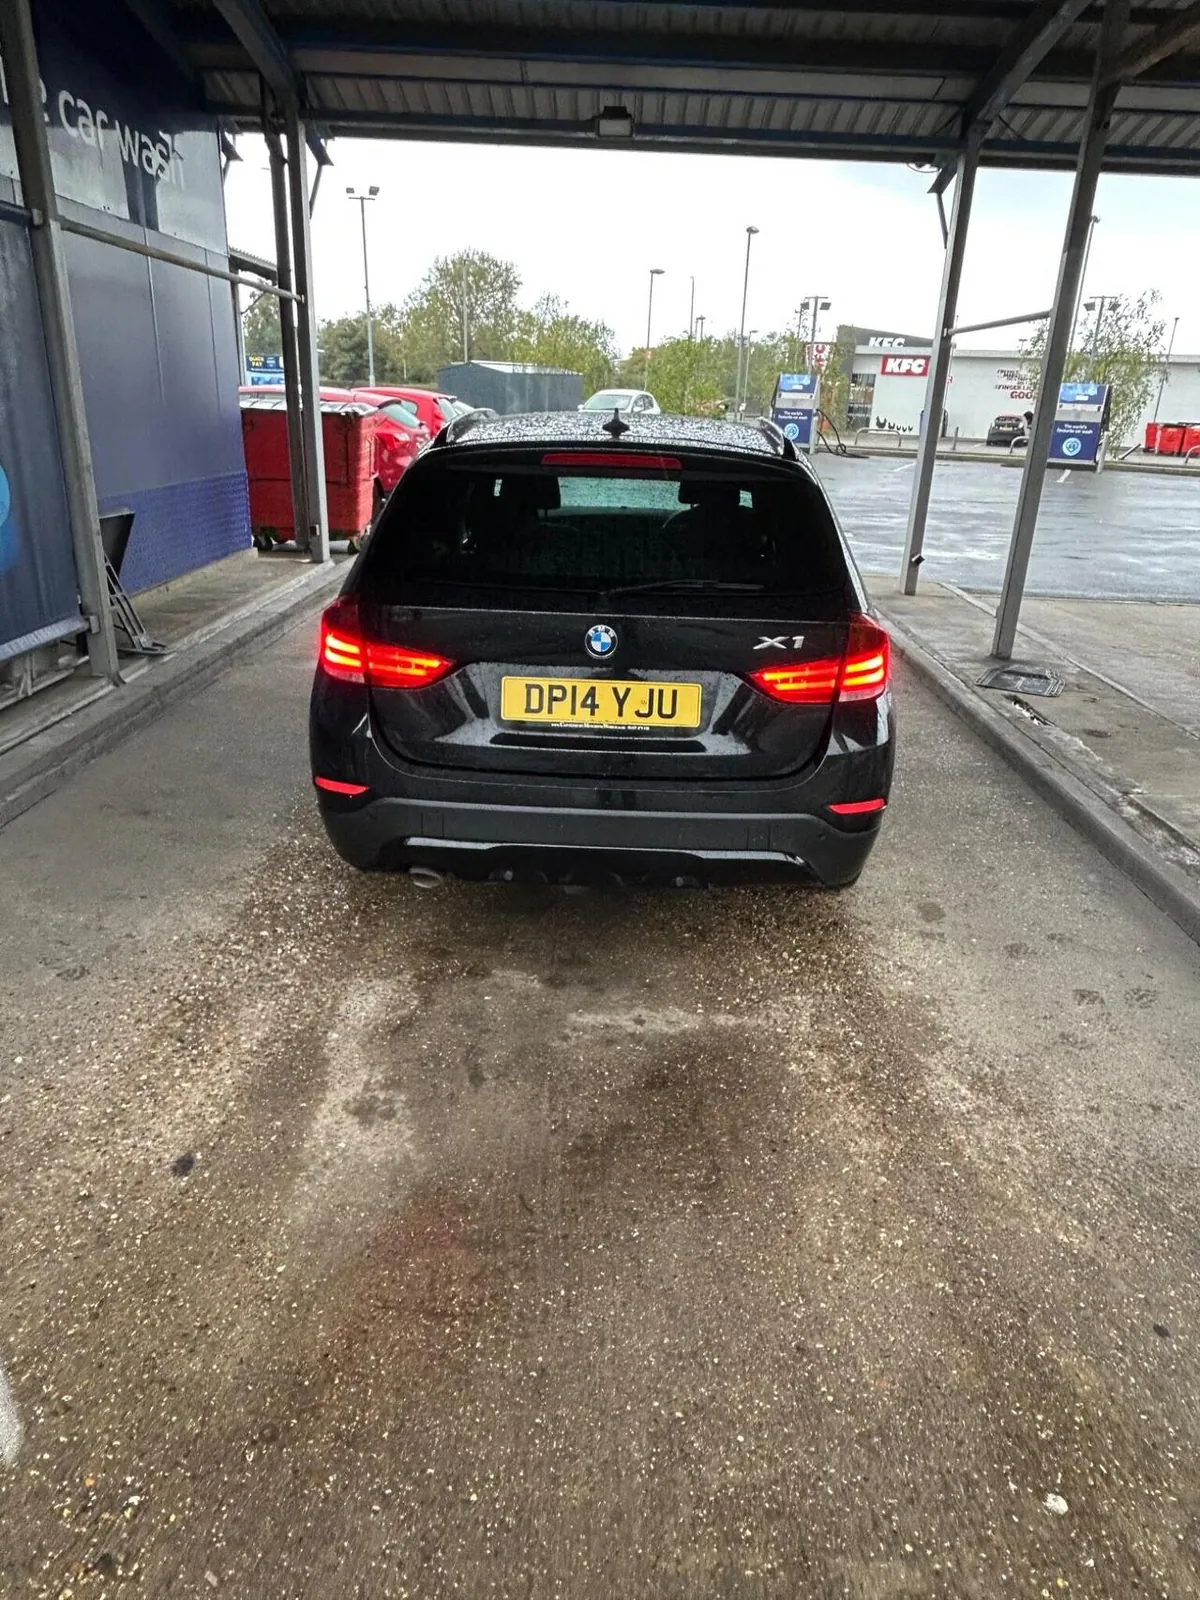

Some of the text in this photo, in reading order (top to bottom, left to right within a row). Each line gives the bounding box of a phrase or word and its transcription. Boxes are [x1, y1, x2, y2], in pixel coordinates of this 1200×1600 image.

[58, 90, 108, 153] car
[869, 337, 906, 348] KFC
[885, 358, 926, 374] KFC
[1010, 391, 1036, 400] GOO
[753, 636, 804, 649] X1
[525, 684, 678, 719] DP14 YJU
